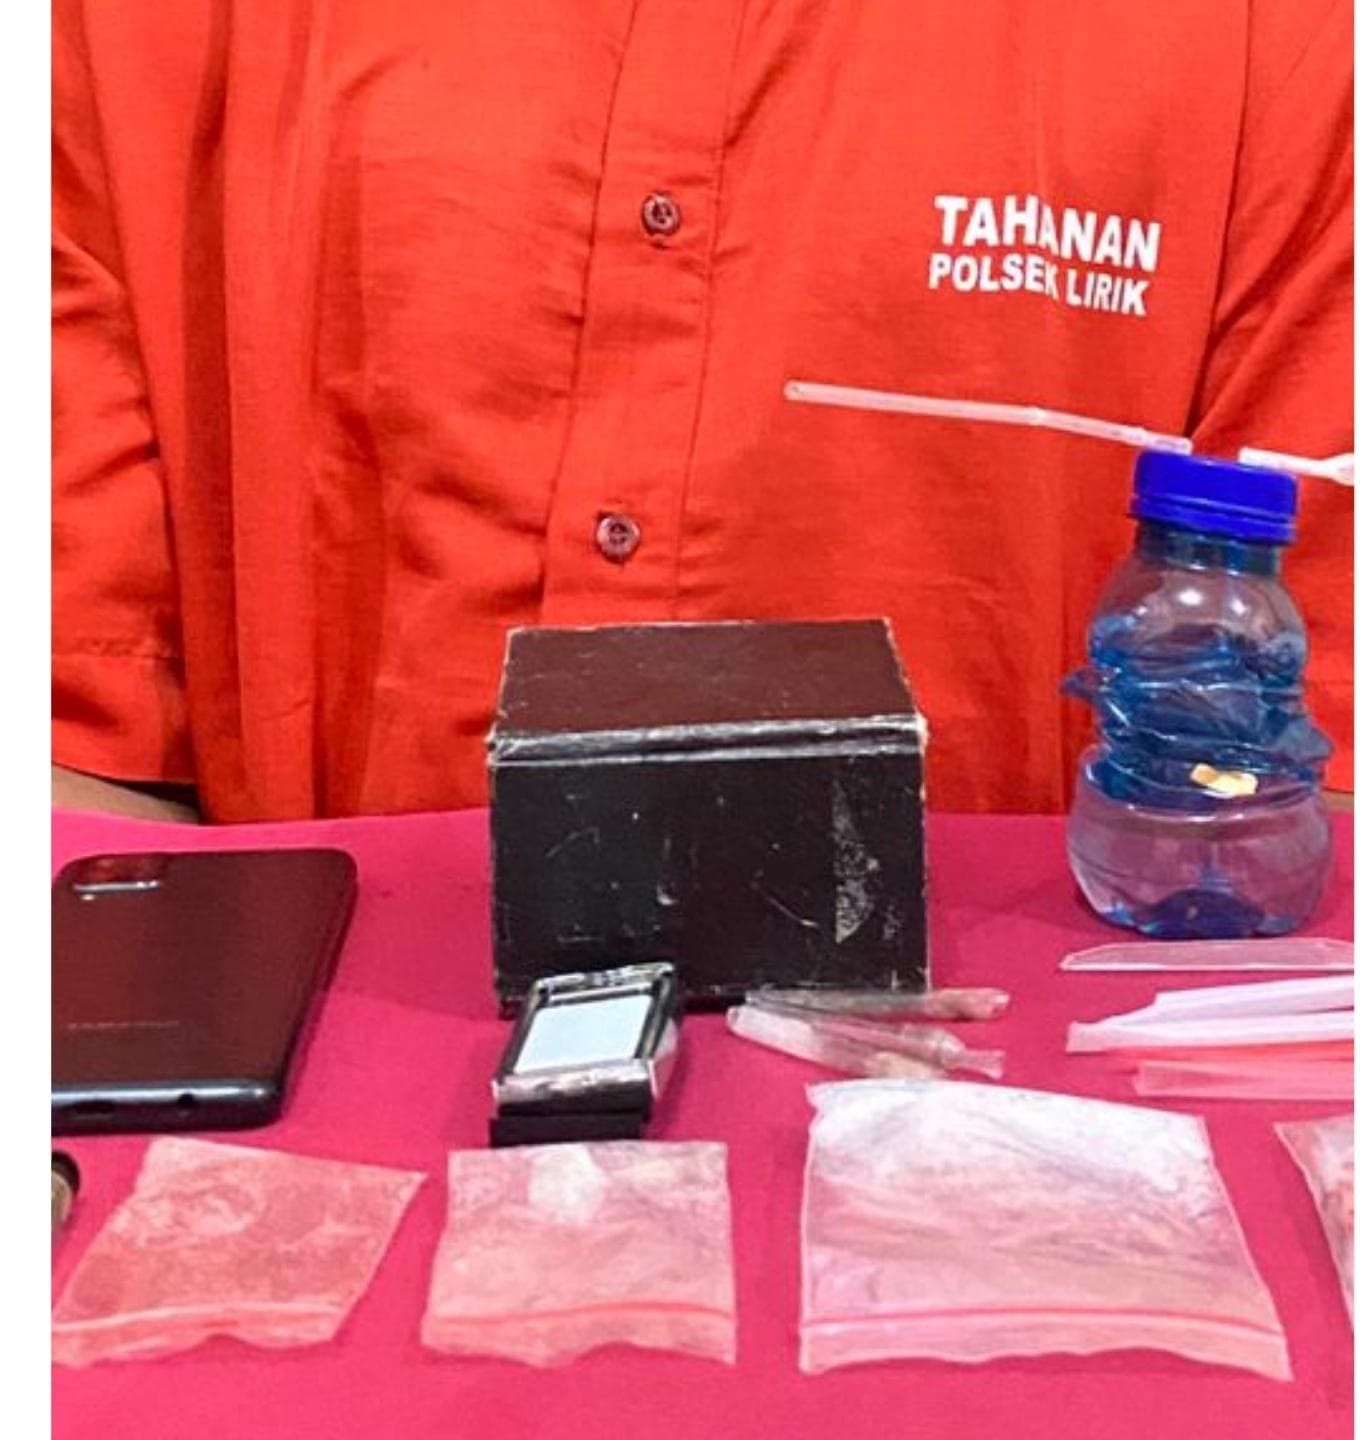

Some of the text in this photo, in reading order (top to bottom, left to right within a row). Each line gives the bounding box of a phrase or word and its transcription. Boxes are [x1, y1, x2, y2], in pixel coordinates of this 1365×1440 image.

[934, 194, 1161, 272] TAHANAN
[928, 252, 1149, 317] POLSEK LIRIK
